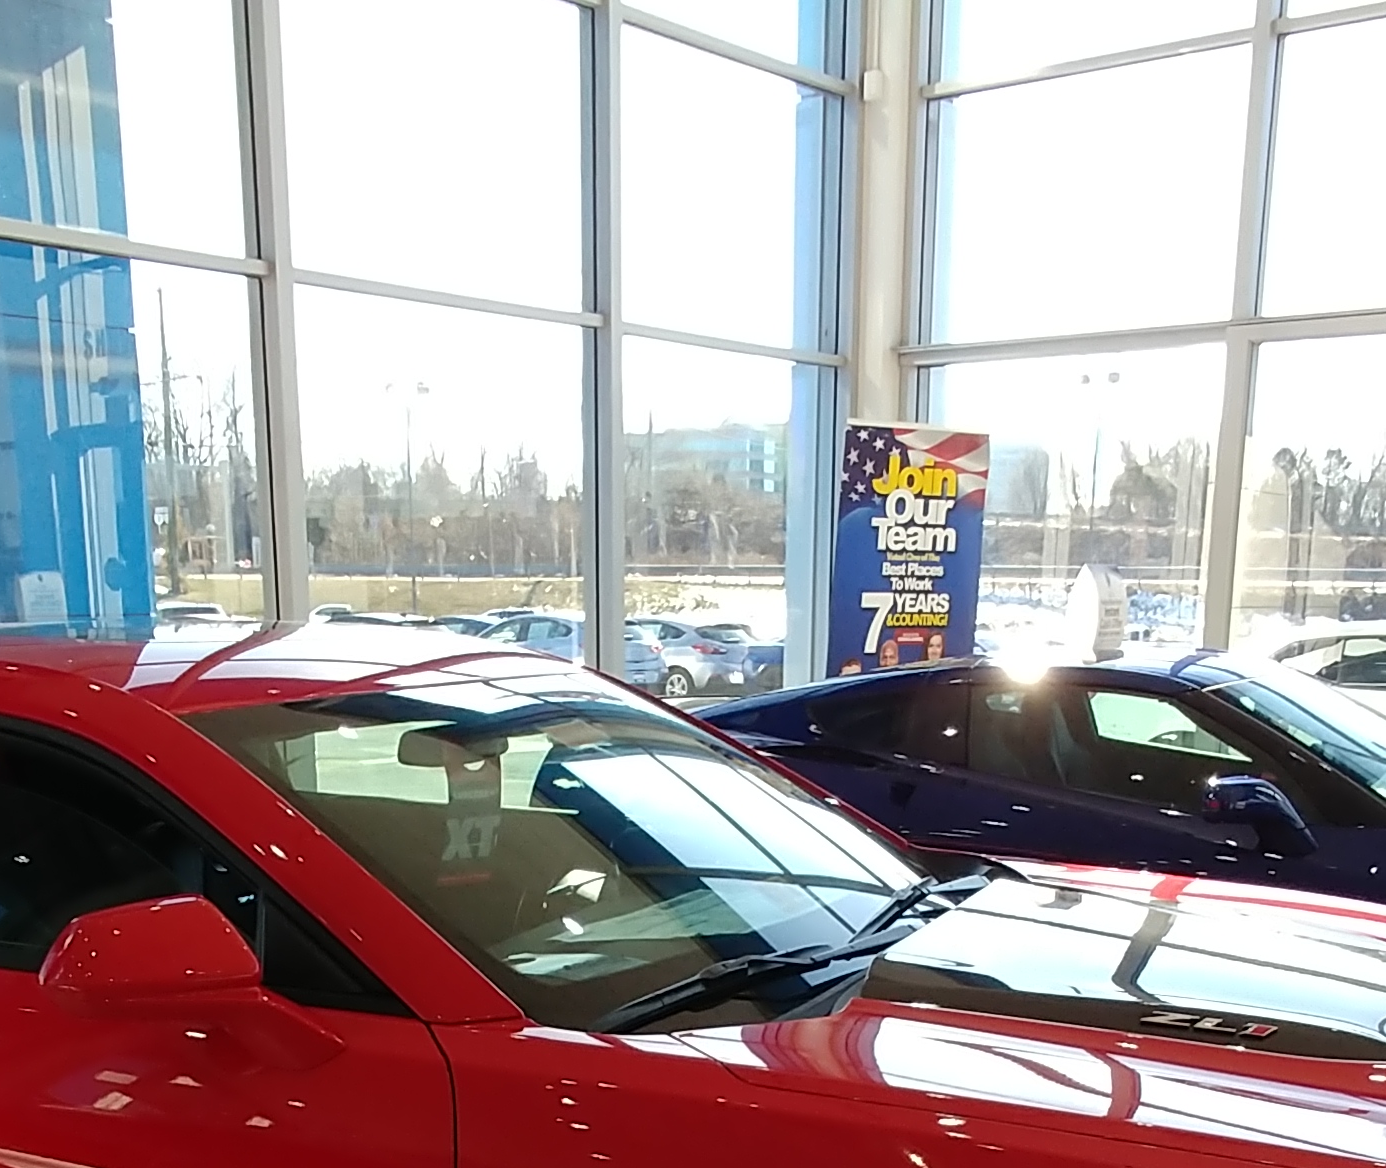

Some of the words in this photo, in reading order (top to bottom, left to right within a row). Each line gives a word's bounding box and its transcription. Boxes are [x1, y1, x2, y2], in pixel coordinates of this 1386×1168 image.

[872, 454, 957, 497] Join
[885, 488, 956, 525] Our
[871, 517, 957, 552] Team
[882, 561, 907, 576] Best
[907, 562, 944, 577] Places
[890, 577, 904, 591] To
[904, 577, 933, 591] Work
[861, 592, 894, 654] 7
[895, 593, 950, 614] YEARS
[1140, 1010, 1279, 1037] ZL1
